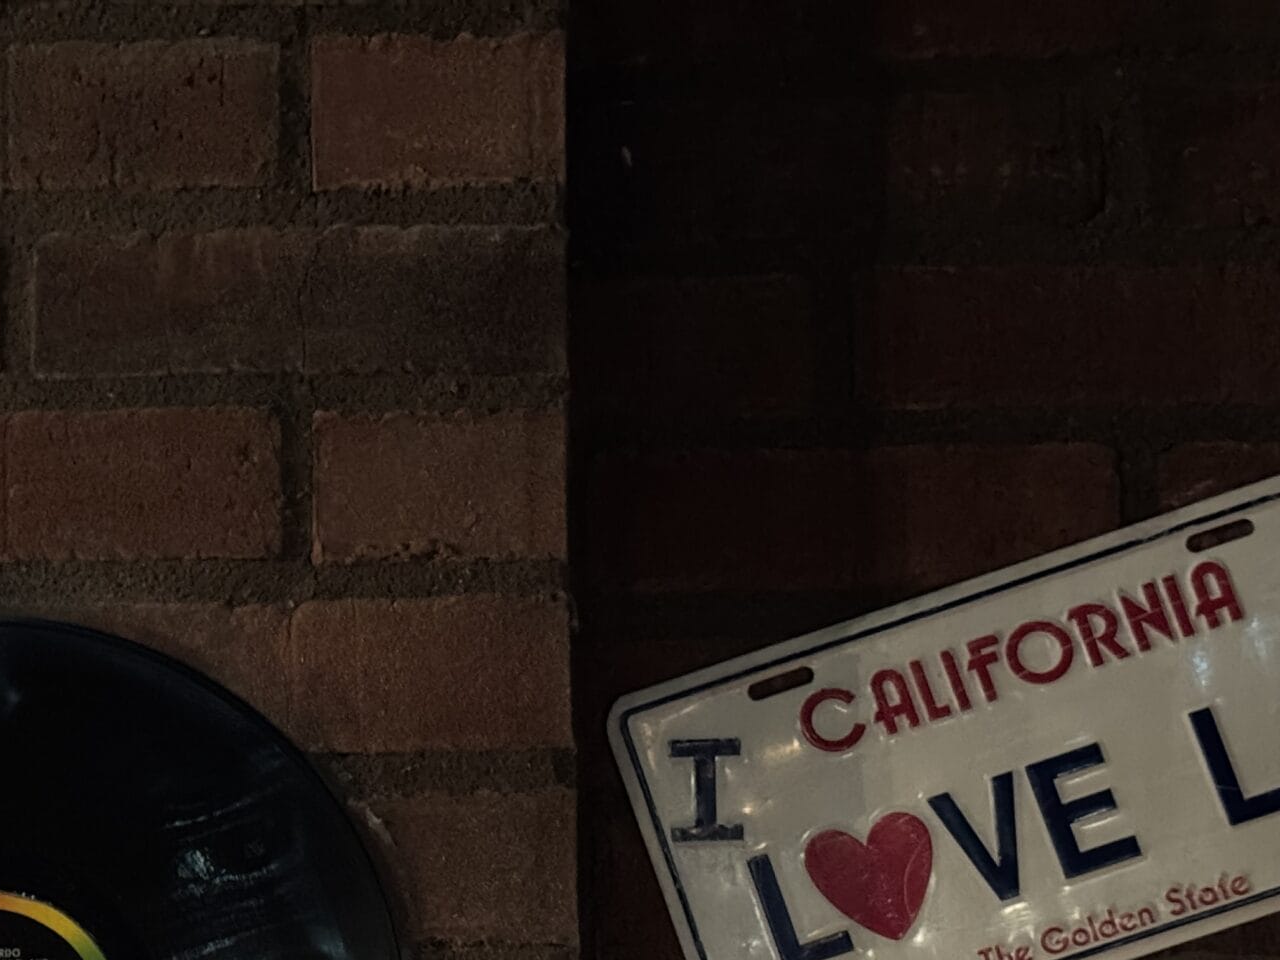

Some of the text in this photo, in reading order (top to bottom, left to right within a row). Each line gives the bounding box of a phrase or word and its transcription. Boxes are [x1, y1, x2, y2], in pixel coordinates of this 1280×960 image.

[799, 561, 1244, 753] CALIFORNIA
[668, 737, 745, 842] I
[1040, 907, 1156, 955] Golden
[1164, 872, 1252, 917] State
